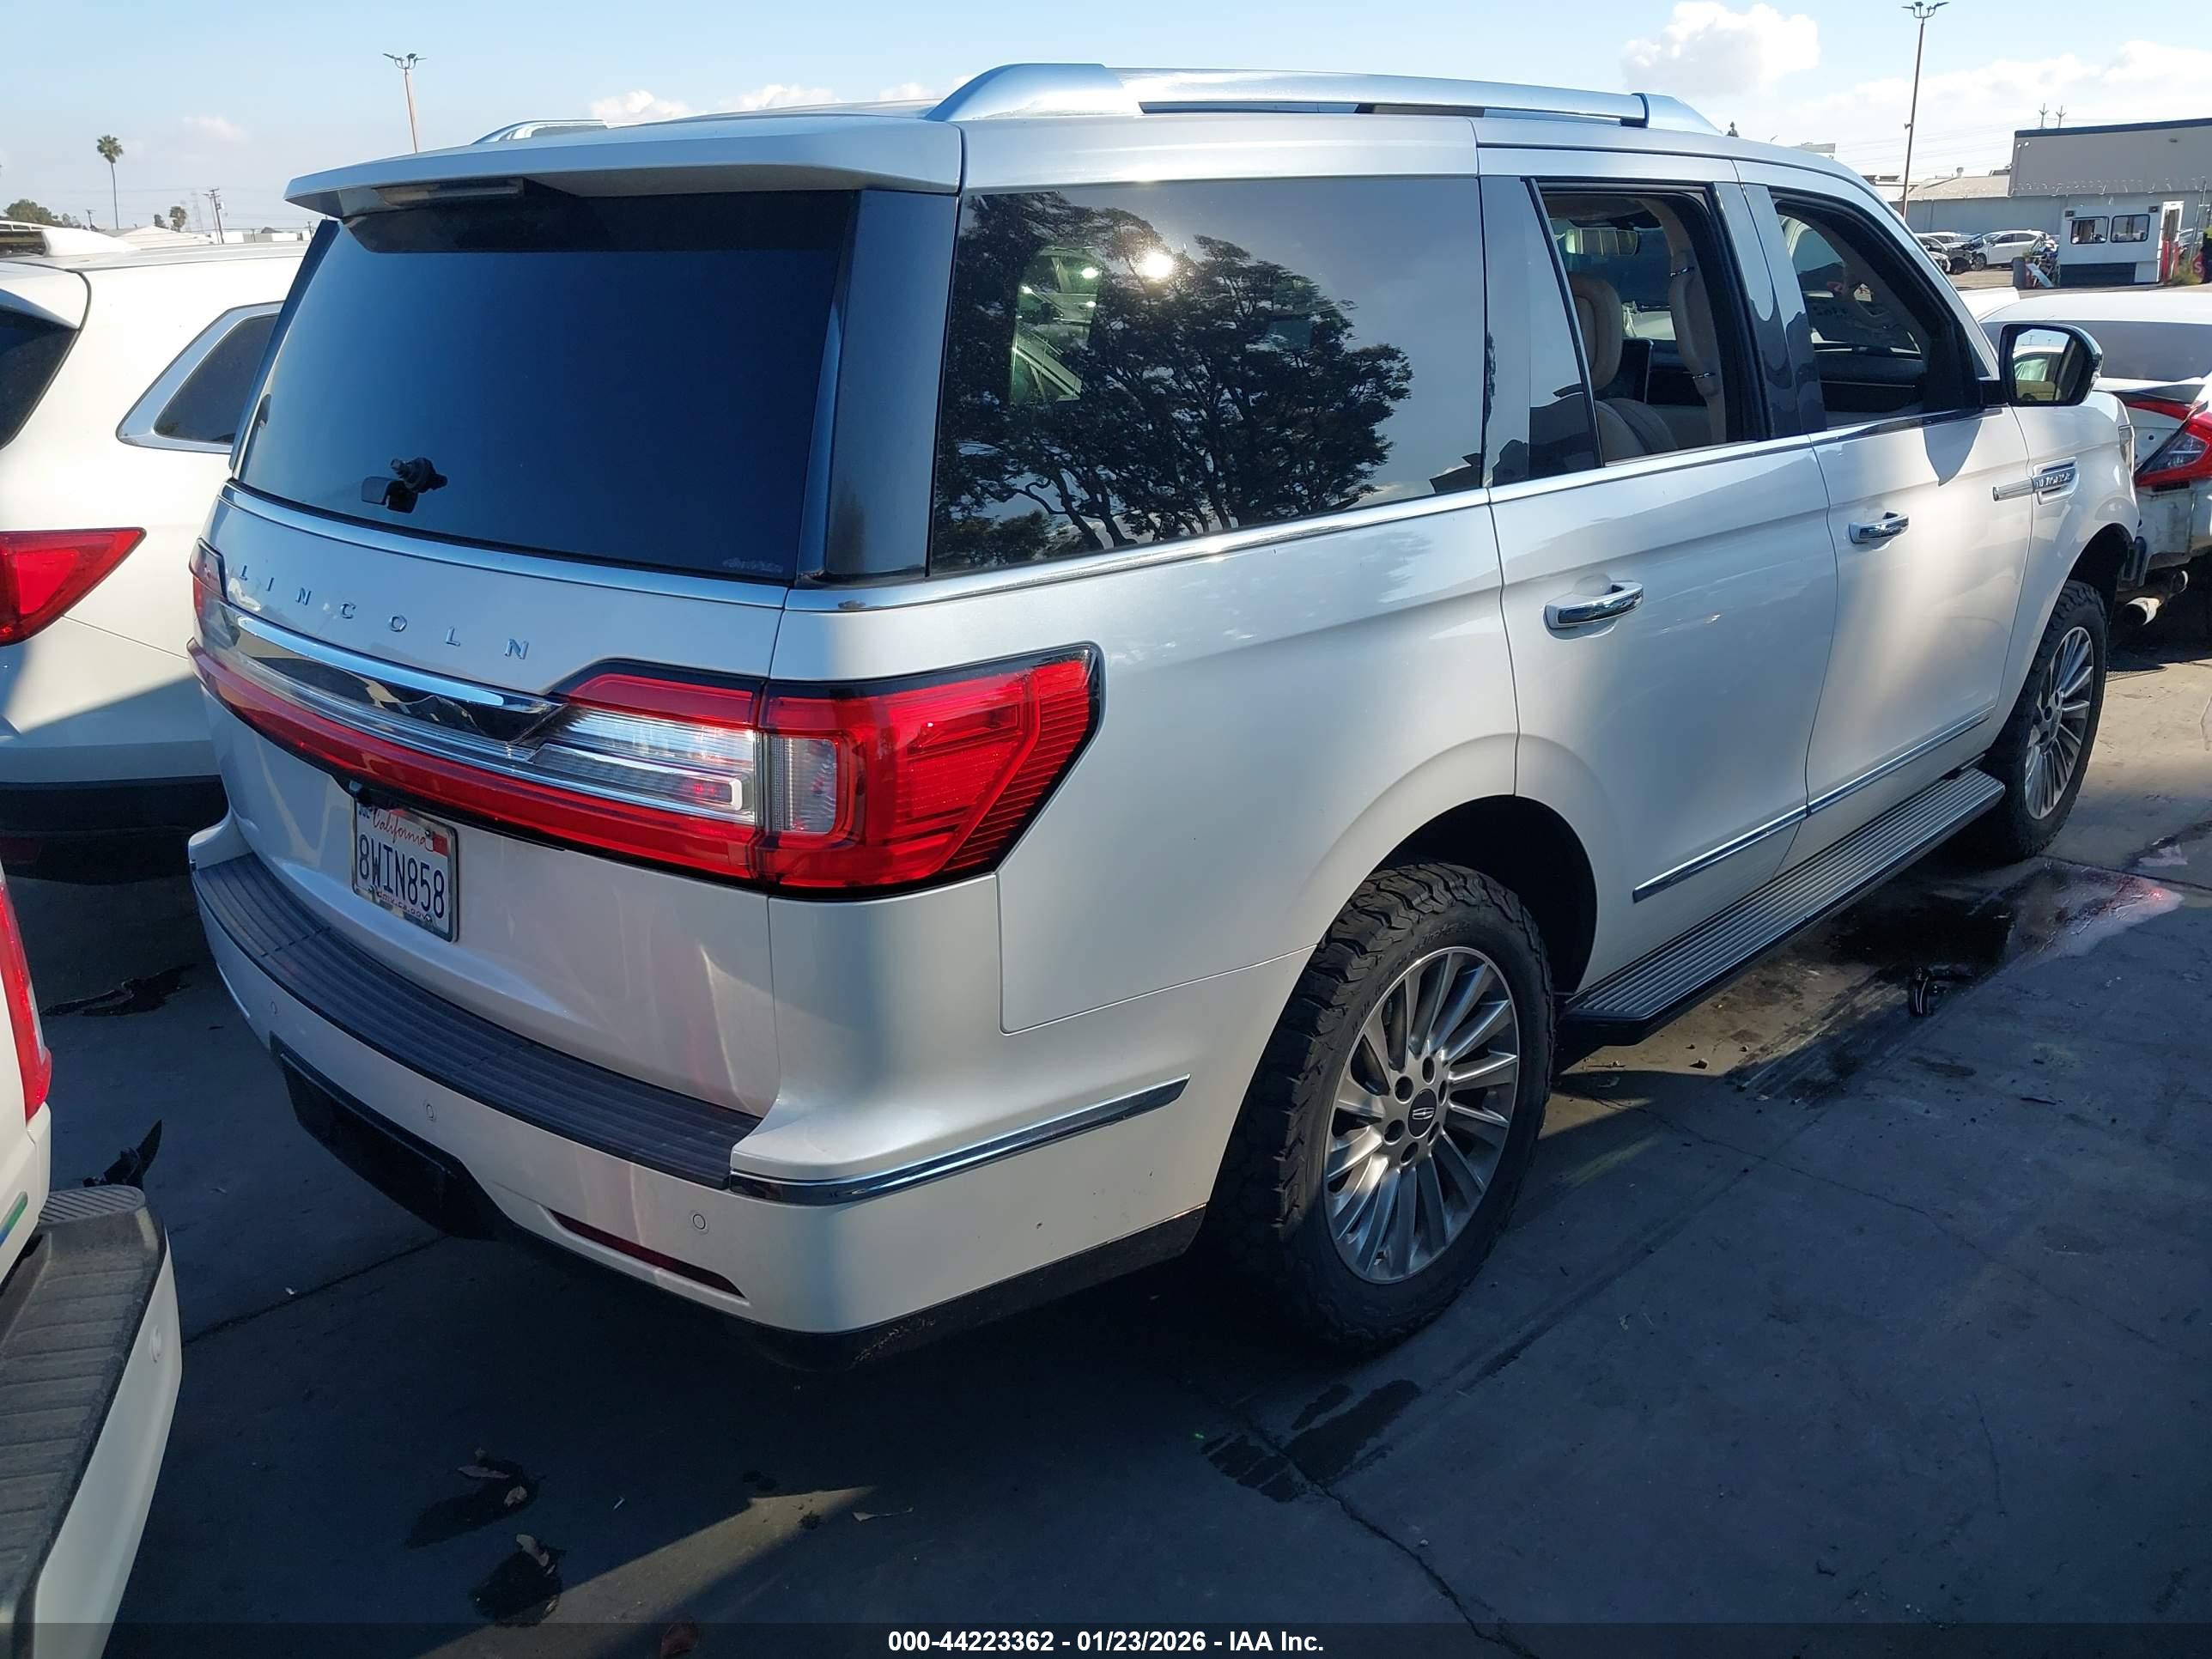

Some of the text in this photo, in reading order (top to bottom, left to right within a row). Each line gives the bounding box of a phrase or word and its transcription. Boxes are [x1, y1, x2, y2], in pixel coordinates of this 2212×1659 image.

[240, 564, 530, 659] LINCOLN
[372, 808, 433, 852] California
[359, 834, 445, 919] 8WIN858
